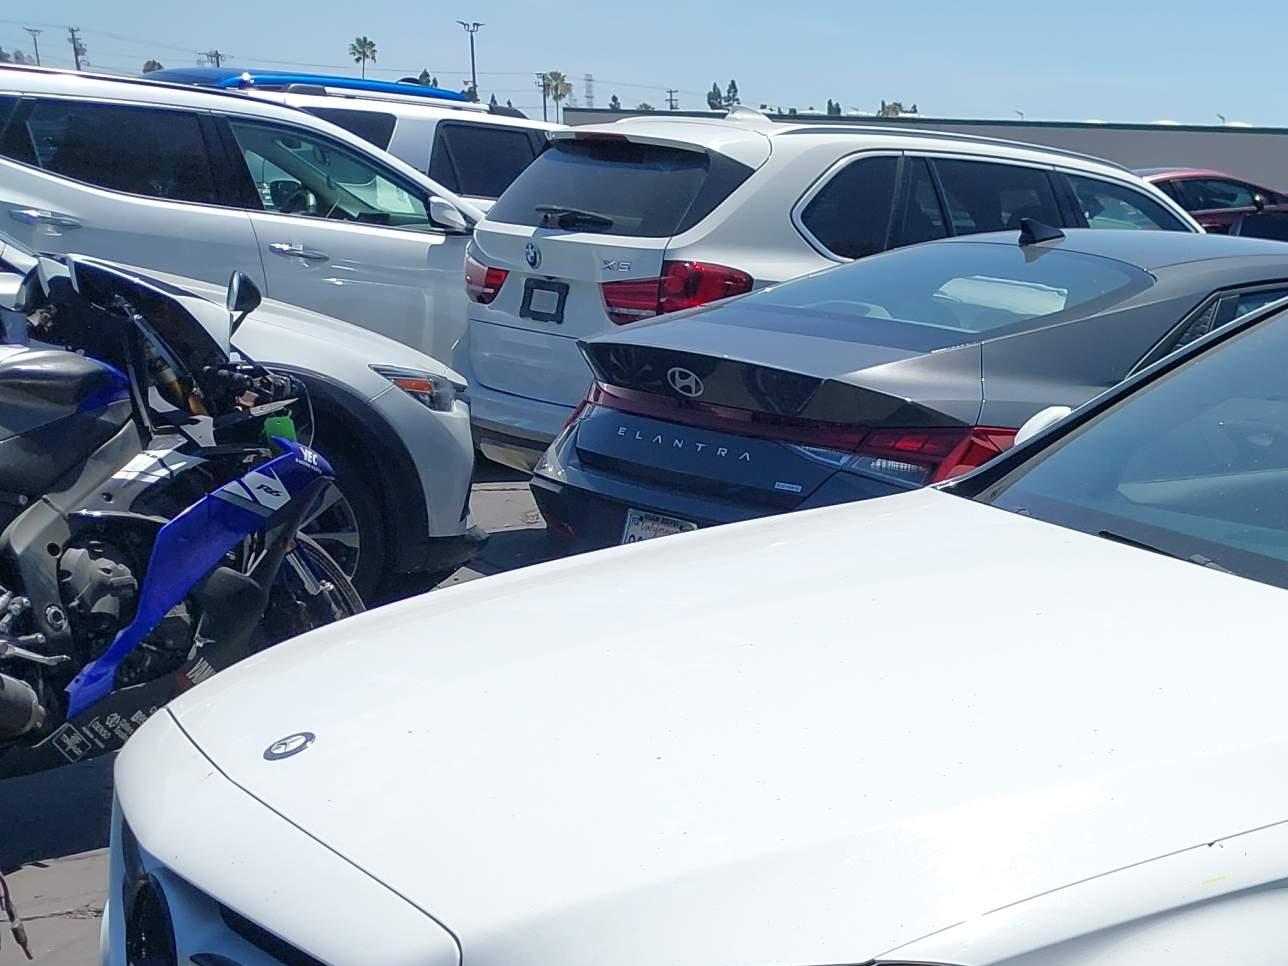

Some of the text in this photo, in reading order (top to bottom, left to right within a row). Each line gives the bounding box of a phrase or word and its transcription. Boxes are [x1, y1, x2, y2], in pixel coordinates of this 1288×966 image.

[602, 259, 632, 272] X5
[617, 426, 751, 462] ELANTRA
[256, 484, 282, 497] R6
